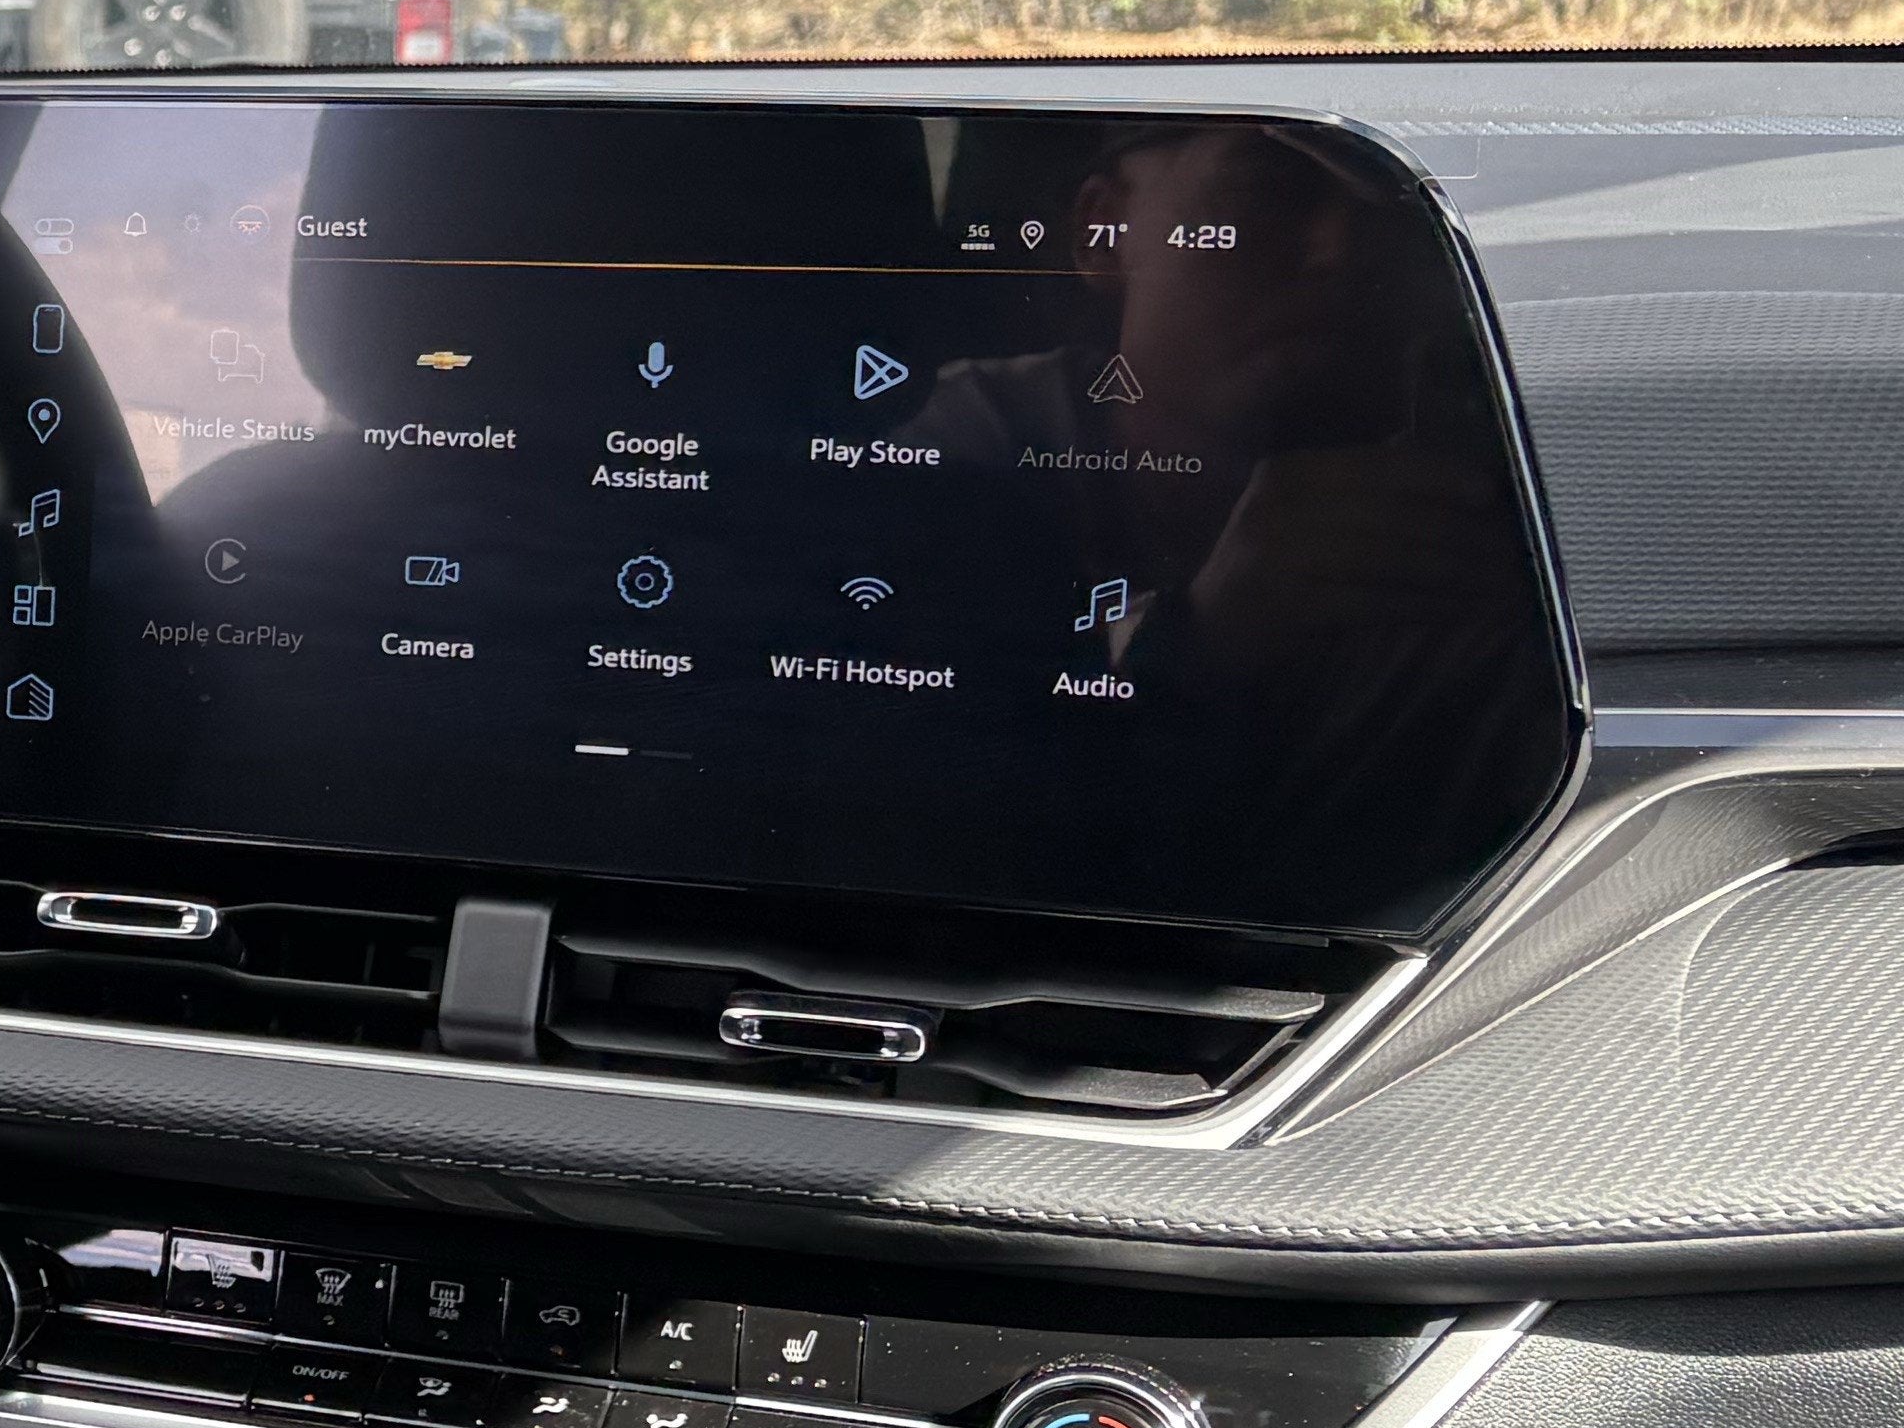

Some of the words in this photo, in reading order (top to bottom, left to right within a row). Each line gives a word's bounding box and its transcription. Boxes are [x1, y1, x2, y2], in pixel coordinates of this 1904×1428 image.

[296, 214, 369, 241] Guest
[968, 224, 990, 238] 5G
[1088, 223, 1128, 248] 71°
[1167, 224, 1237, 249] 4:29
[152, 417, 236, 442] Vehicle
[240, 418, 315, 441] Status
[363, 423, 517, 451] myChevrolet
[606, 430, 699, 462] Google
[810, 437, 864, 469] Play
[869, 440, 941, 465] Store
[1017, 445, 1129, 471] Android
[1136, 450, 1202, 474] Auto
[591, 464, 710, 491] Assistant
[141, 619, 210, 648] Apple
[216, 623, 304, 654] CarPlay
[381, 632, 474, 659] Camera
[587, 644, 693, 678] Settings
[770, 655, 839, 681] Wi-Fi
[846, 659, 955, 692] Hotspot
[1052, 671, 1135, 699] Audio
[316, 1291, 344, 1307] MAX
[428, 1306, 460, 1321] REAR
[660, 1320, 693, 1341] A/C
[292, 1365, 349, 1381] ON/OFF
